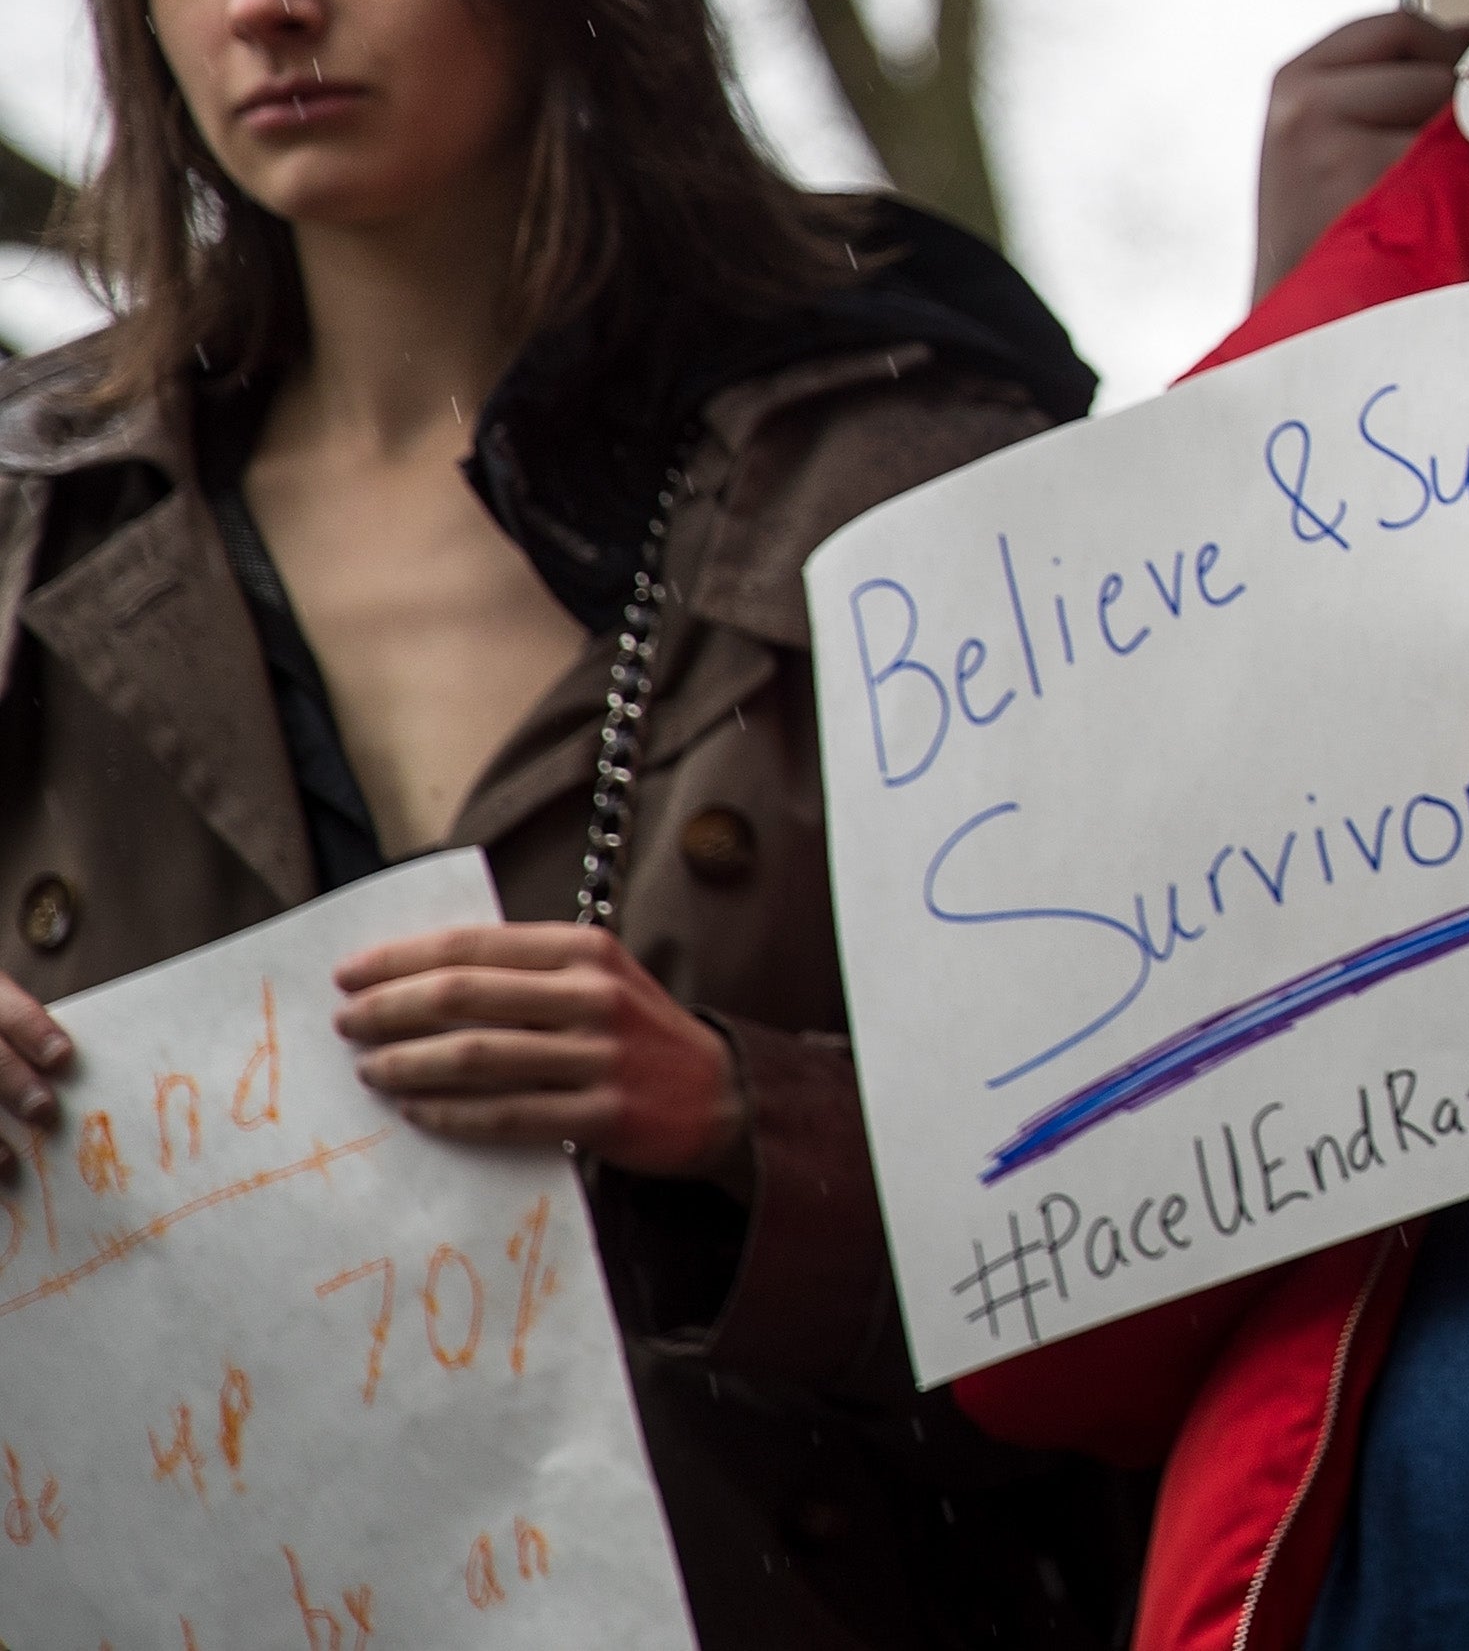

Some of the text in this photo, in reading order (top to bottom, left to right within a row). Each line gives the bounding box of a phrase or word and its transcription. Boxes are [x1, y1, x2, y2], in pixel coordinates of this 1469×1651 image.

[849, 532, 1246, 788] Believe
[1266, 419, 1350, 550] &
[315, 1195, 561, 1405] 70%
[466, 1515, 550, 1610] an
